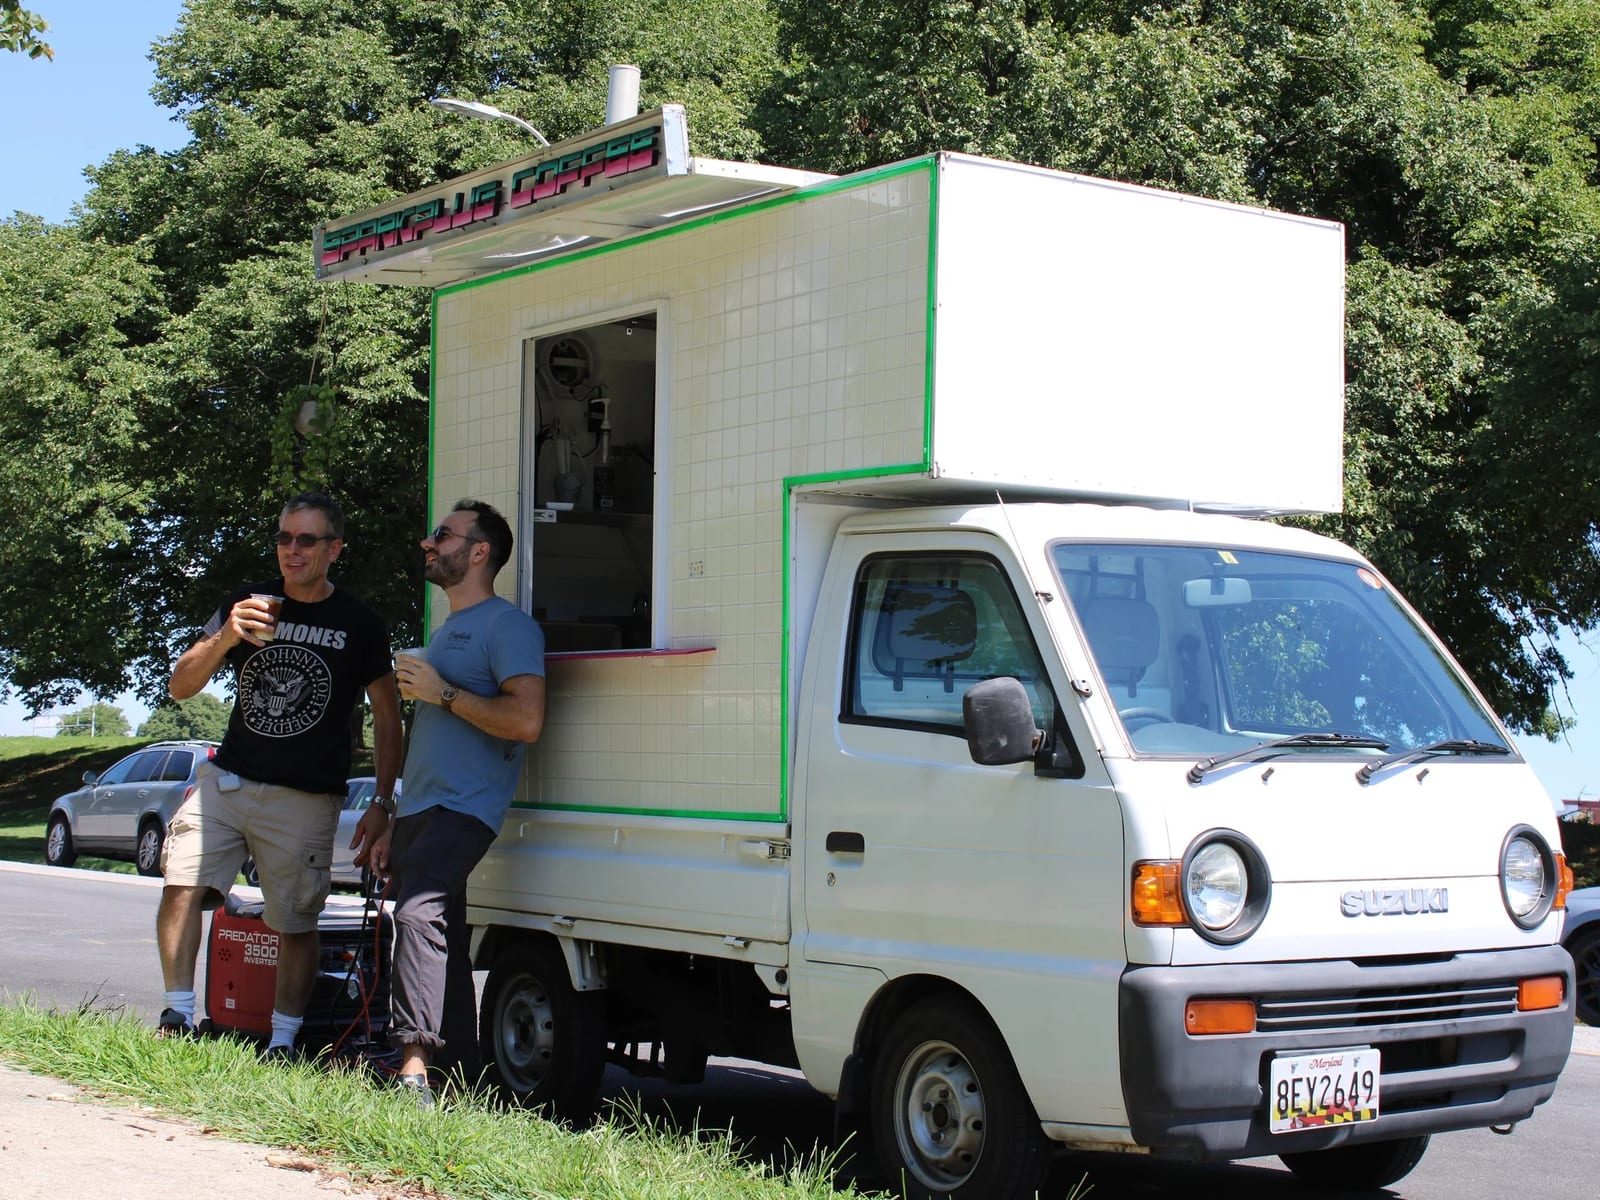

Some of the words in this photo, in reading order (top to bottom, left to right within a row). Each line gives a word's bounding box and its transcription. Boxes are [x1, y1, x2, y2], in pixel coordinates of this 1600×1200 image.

[321, 180, 502, 265] SPARKPLUG
[511, 126, 661, 209] COFFEE
[274, 621, 347, 650] MONES
[259, 648, 321, 670] JOHNNY
[241, 665, 255, 719] TOMMY
[313, 677, 329, 710] JOEY
[1340, 887, 1448, 917] SUZUKI
[218, 929, 279, 946] PREDATOR
[244, 943, 278, 959] 3500
[244, 956, 278, 966] INVERTER
[1309, 1055, 1344, 1071] Maryland
[1277, 1069, 1374, 1114] 8EY2649
